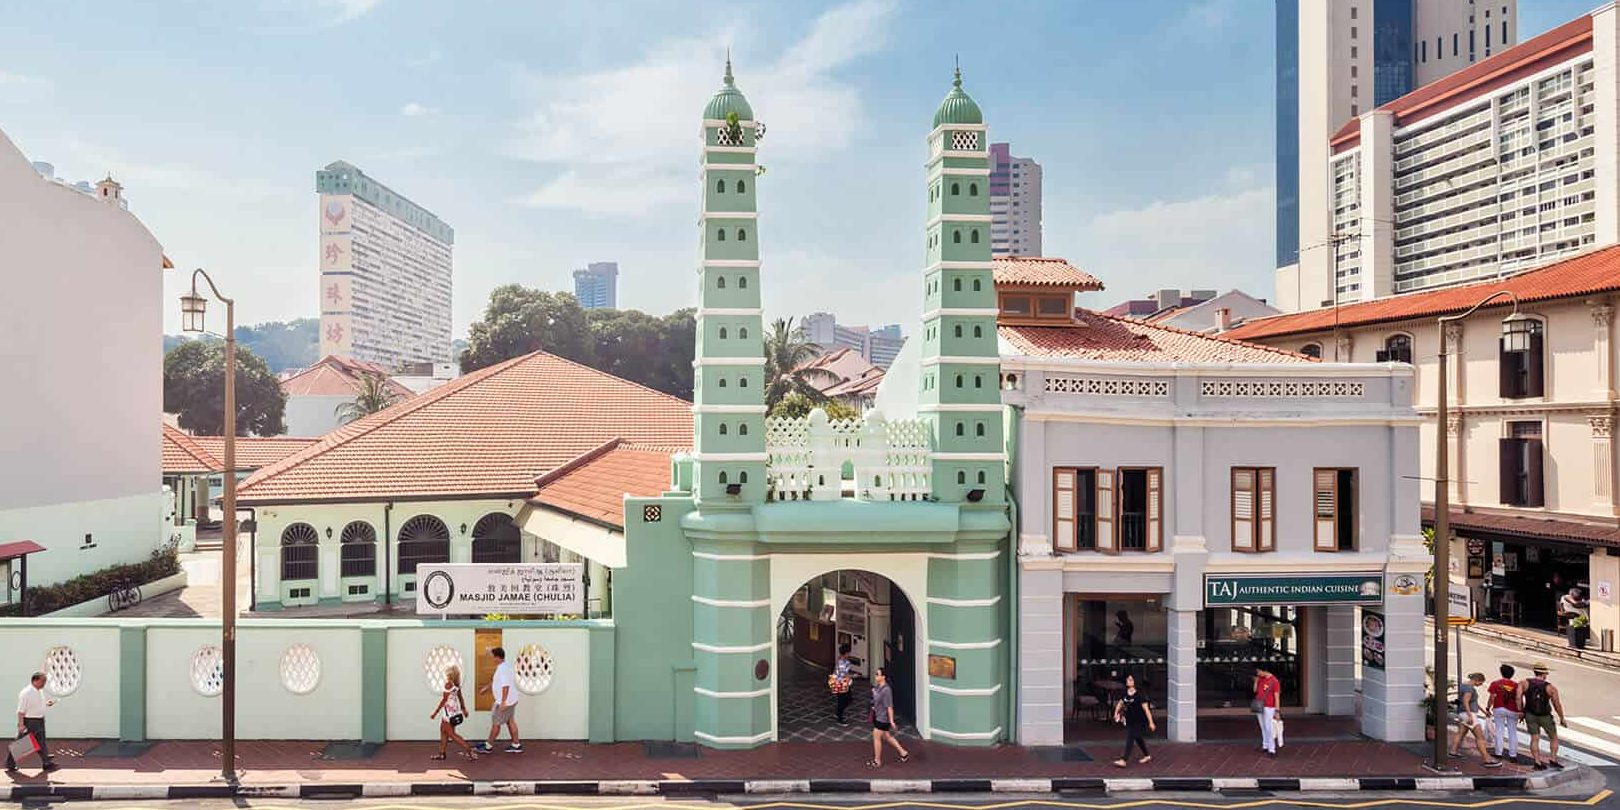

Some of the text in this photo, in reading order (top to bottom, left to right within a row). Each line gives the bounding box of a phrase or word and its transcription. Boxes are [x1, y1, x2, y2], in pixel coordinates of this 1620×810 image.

[459, 593, 576, 602] MASJID JAMAE (CHULIA)
[1208, 581, 1359, 600] TAJ AUTHENTIC INDIAN CUISINE
